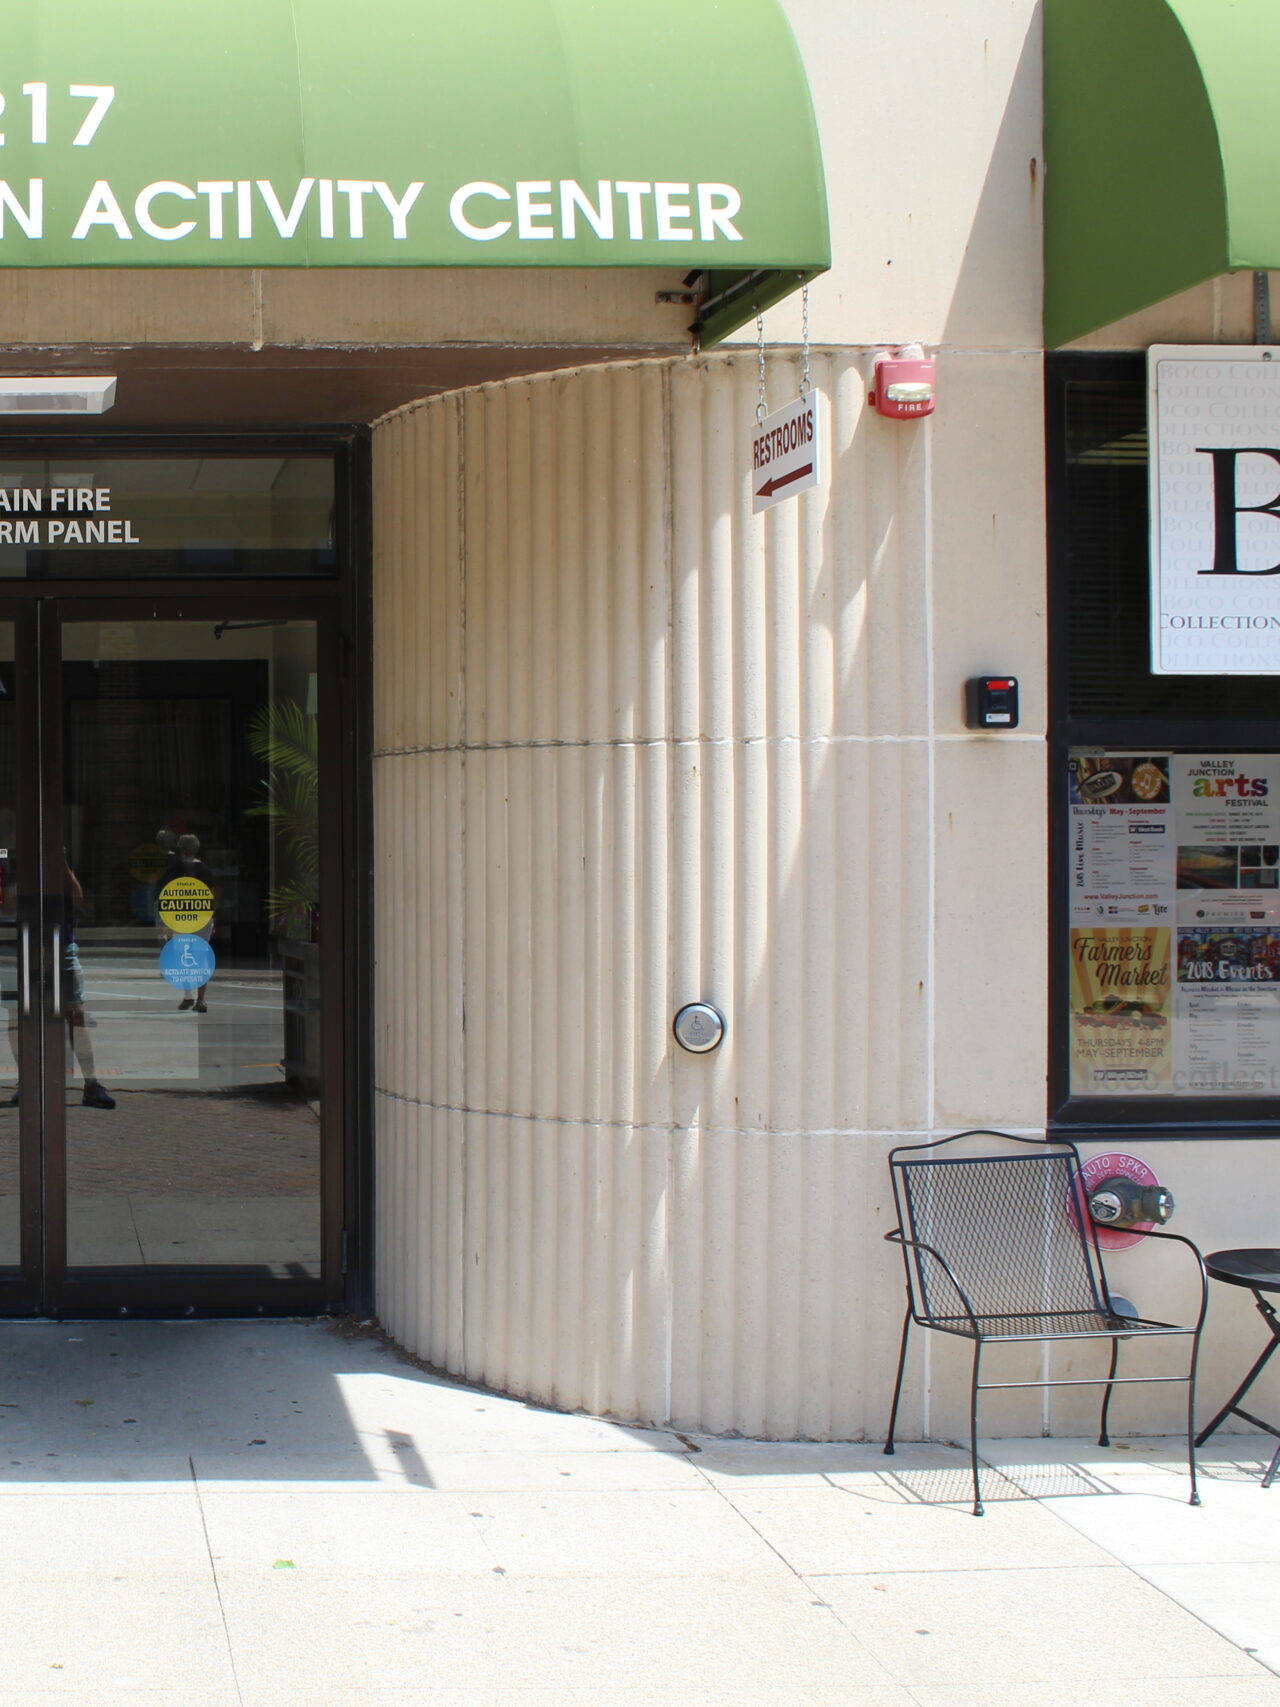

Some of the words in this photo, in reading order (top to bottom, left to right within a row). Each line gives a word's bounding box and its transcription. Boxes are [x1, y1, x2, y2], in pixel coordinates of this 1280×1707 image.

[71, 177, 425, 241] ACTIVITY
[448, 178, 744, 242] CENTER
[898, 404, 922, 412] FIRE
[754, 409, 813, 470] RESTROOMS
[50, 488, 111, 512] FIRE
[47, 520, 140, 544] PANEL
[1200, 760, 1235, 769] VALLEY
[1187, 768, 1235, 777] JUNCTION
[1192, 773, 1269, 798] arts
[1224, 799, 1269, 807] FESTIVAL
[1109, 807, 1124, 816] May
[1128, 807, 1166, 817] September
[162, 888, 211, 897] AUTOMATIC
[160, 899, 212, 911] CAUTION
[175, 913, 199, 922] DOOR
[1073, 937, 1153, 963] Farmers
[1095, 962, 1168, 987] Market
[1186, 962, 1214, 980] 2018
[1218, 961, 1274, 980] Events
[1077, 1038, 1132, 1047] THURSDAYS
[1082, 1158, 1110, 1179] AUTO
[1118, 1156, 1148, 1178] SPKR
